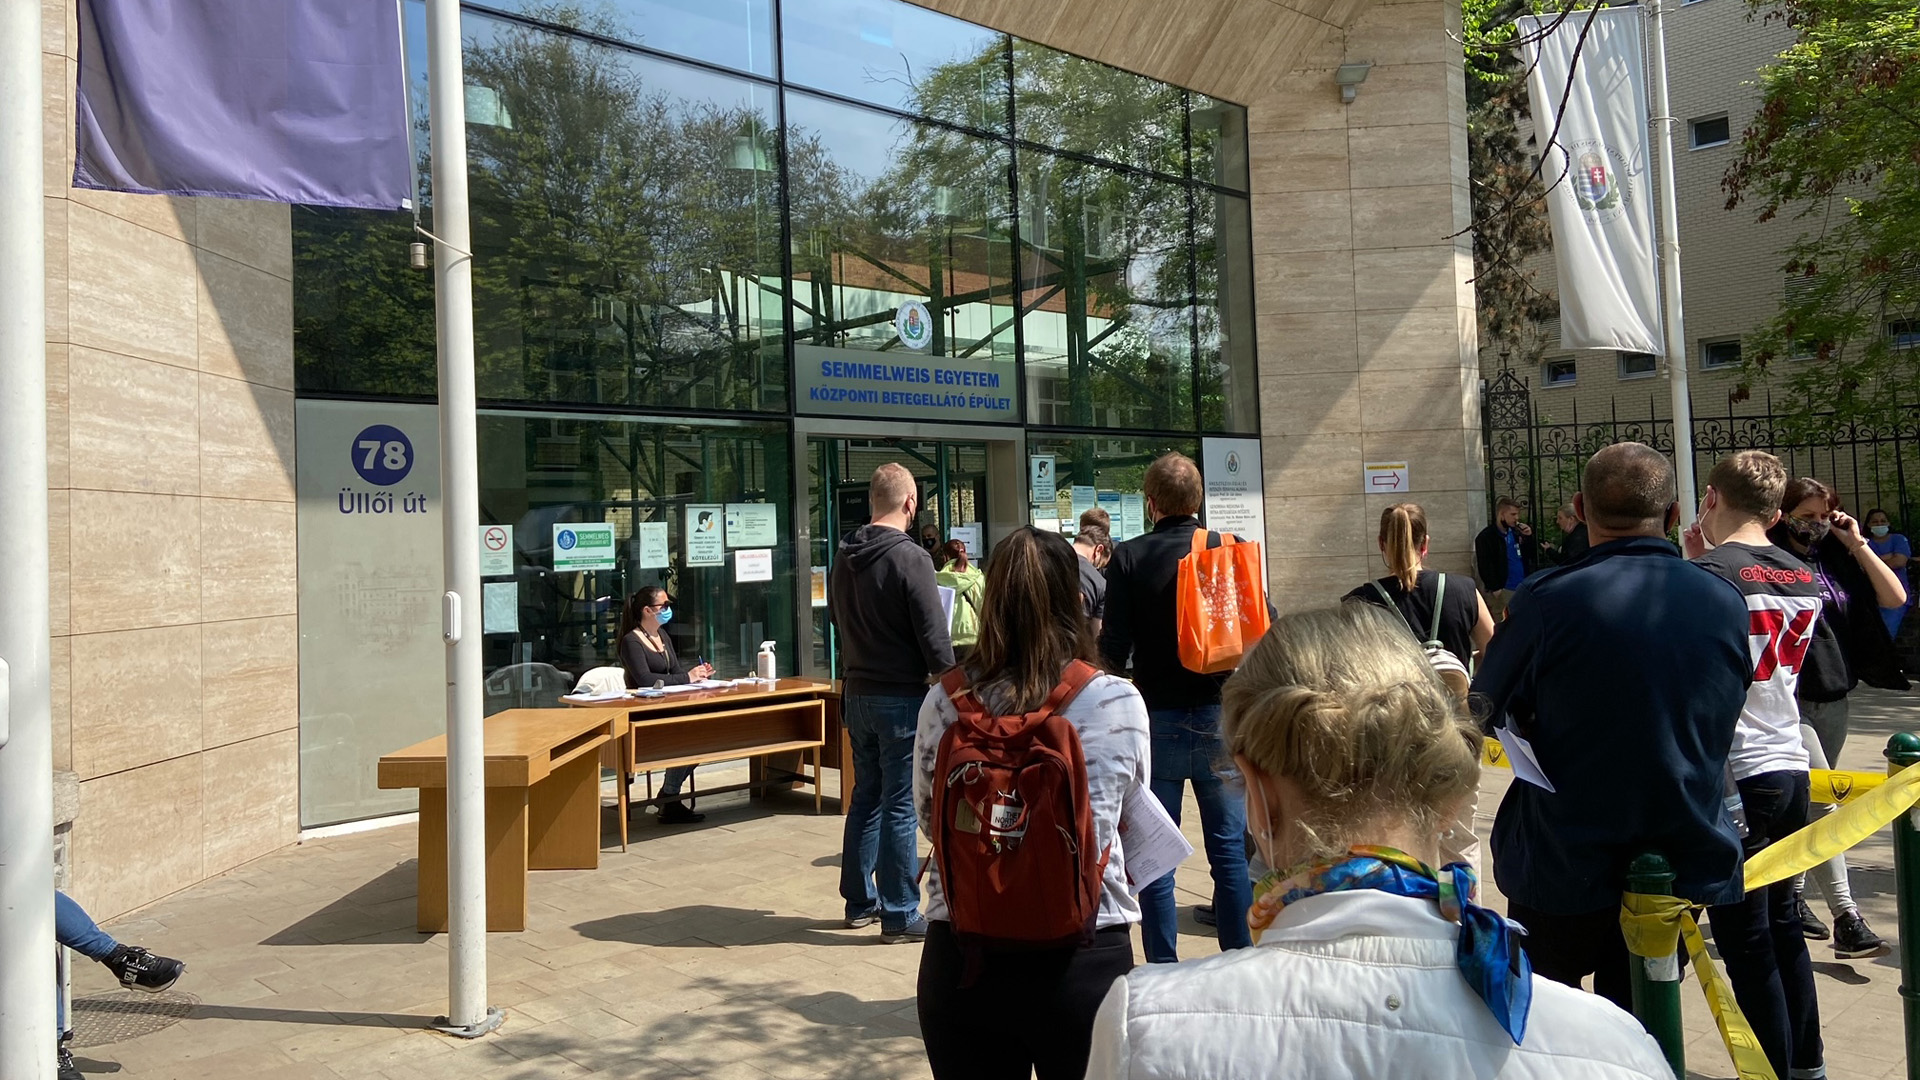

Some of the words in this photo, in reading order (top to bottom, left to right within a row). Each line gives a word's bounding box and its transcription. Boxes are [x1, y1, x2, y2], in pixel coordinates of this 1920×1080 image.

[821, 360, 930, 384] SEMMELWEIS
[934, 369, 1000, 388] EGYETEM
[809, 384, 879, 404] KÖZPONTI
[882, 391, 966, 408] BETEGELLÁTÓ
[969, 392, 1011, 410] ÉPÜLET
[358, 440, 407, 471] 78
[338, 487, 393, 514] Üllői
[403, 491, 428, 514] út
[1740, 564, 1797, 584] adidas
[1748, 608, 1815, 682] 74
[1006, 811, 1018, 820] THE
